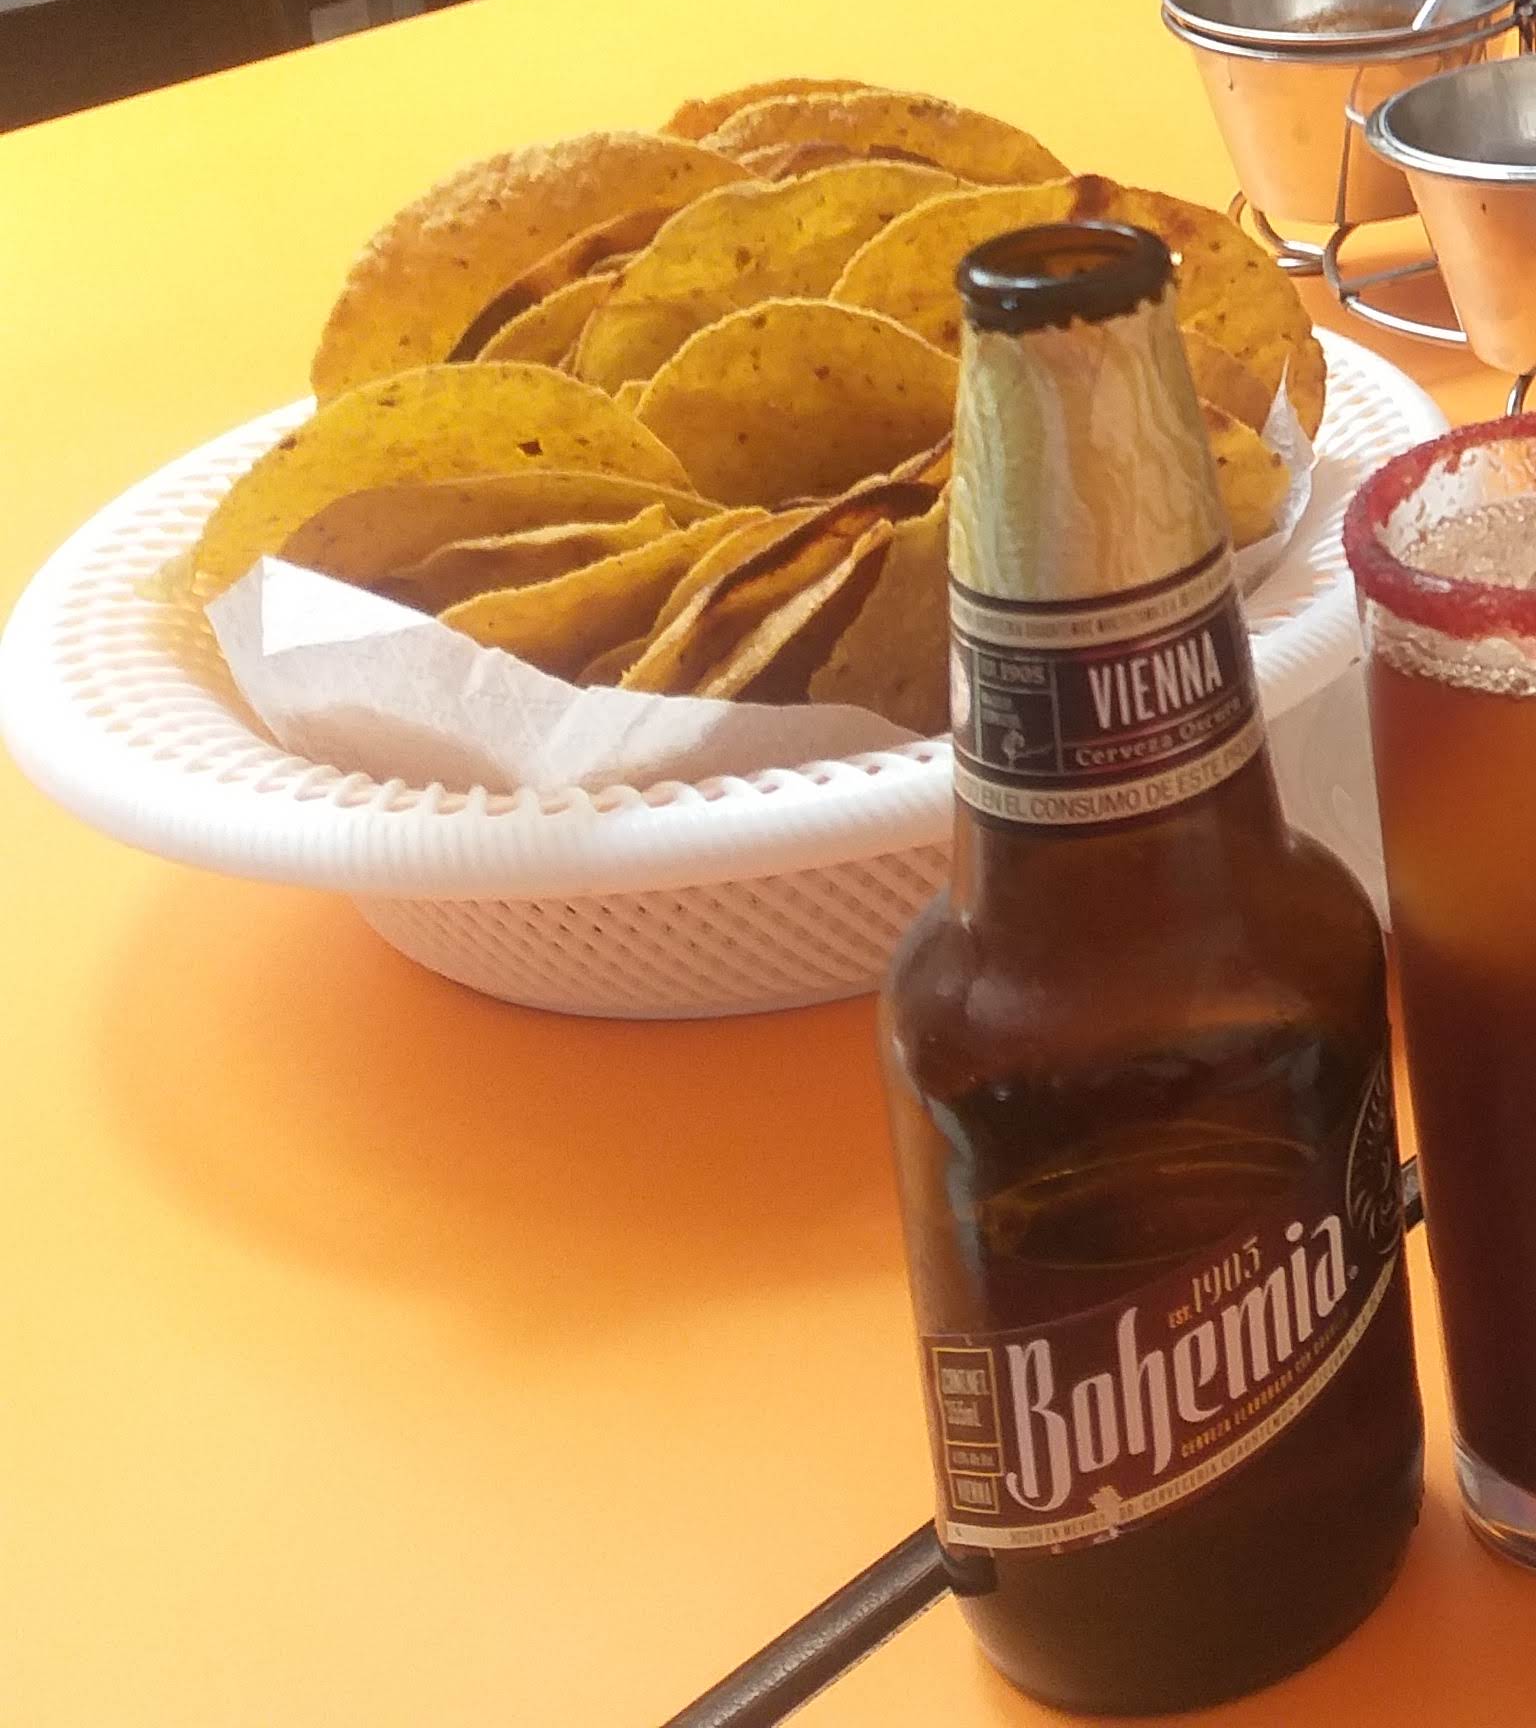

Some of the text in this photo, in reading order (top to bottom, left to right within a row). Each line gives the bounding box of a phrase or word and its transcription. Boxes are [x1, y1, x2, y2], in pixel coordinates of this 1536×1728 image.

[1087, 629, 1224, 731] VIENNA
[1074, 732, 1175, 768] Cerveza
[1004, 795, 1027, 819] EL
[1029, 789, 1140, 820] CONSUMO
[1146, 777, 1176, 807] DE
[1176, 760, 1223, 797] ESTE
[1192, 1235, 1261, 1314] 1905
[1004, 1214, 1347, 1513] Bohemia
[1180, 1417, 1233, 1459] CERVEZA
